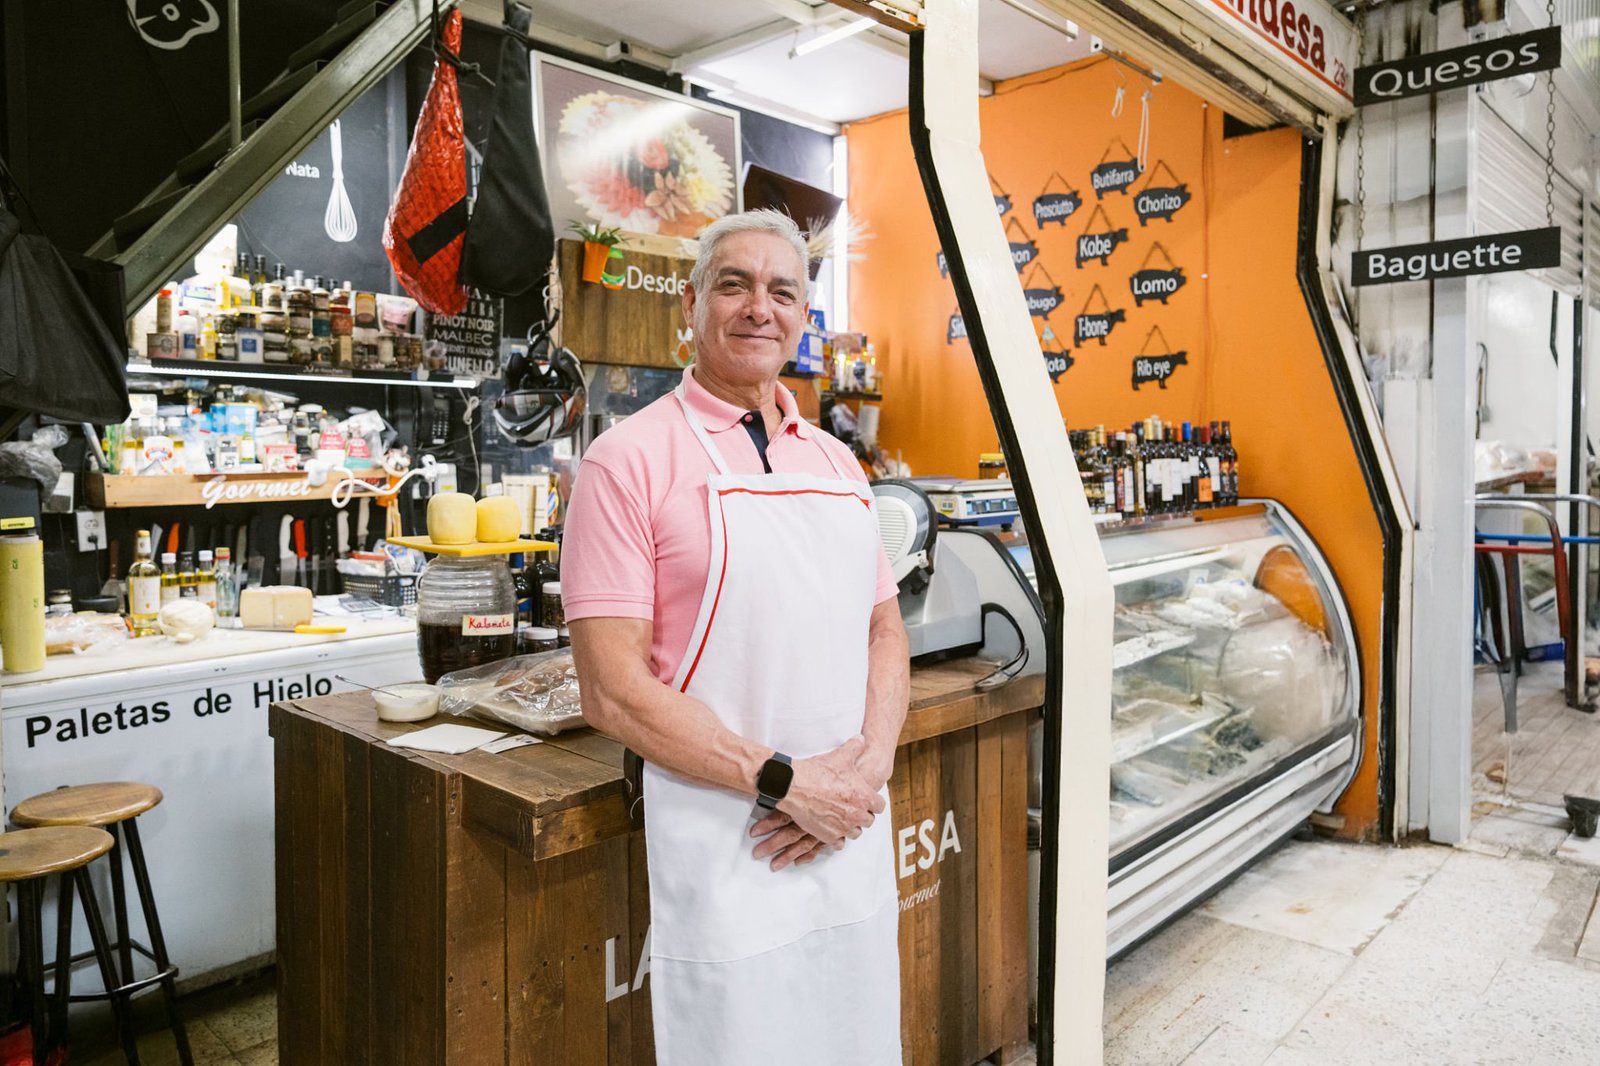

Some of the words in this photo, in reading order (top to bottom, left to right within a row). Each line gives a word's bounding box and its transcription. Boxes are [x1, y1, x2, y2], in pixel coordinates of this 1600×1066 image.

[1369, 41, 1540, 98] Quesos
[285, 161, 320, 179] Nata
[1093, 168, 1135, 189] Butifarra
[1035, 200, 1074, 218] Prosciutto
[1137, 194, 1181, 214] Chorizo
[1080, 234, 1112, 258] Kobe
[1368, 242, 1522, 281] Baguette
[626, 265, 688, 296] Desde
[1133, 278, 1177, 295] Lomo
[432, 314, 466, 329] PINOT
[467, 317, 495, 332] NOIR
[1077, 316, 1109, 338] T-bone
[433, 328, 493, 346] MALBEC
[1136, 359, 1153, 377] Rib
[1153, 360, 1171, 379] eye
[202, 475, 312, 510] Gourmet
[26, 700, 171, 748] Paletas
[193, 687, 233, 718] de
[253, 673, 332, 708] Hielo
[898, 809, 962, 879] ESA
[897, 878, 941, 912] ourmet
